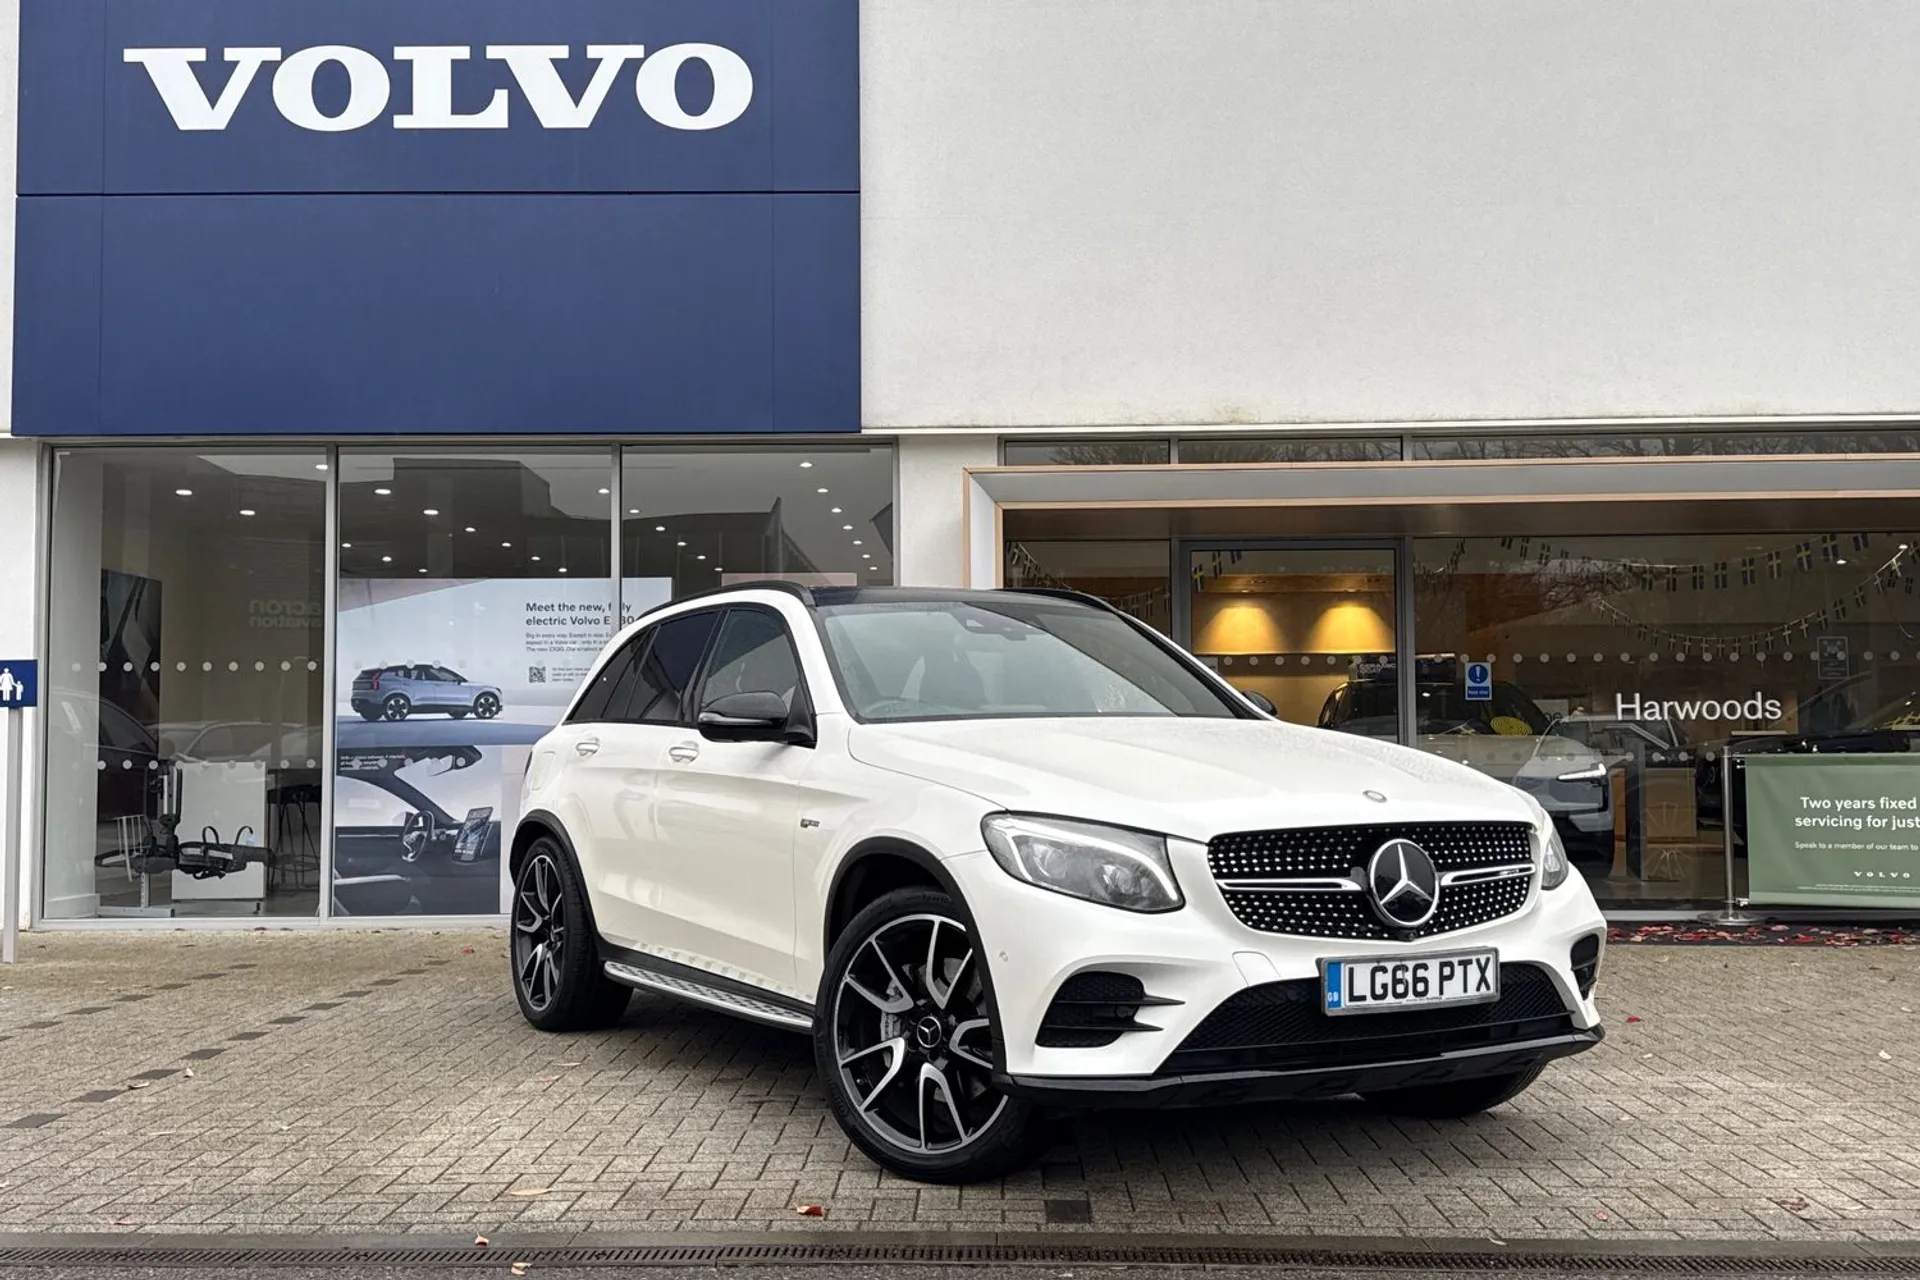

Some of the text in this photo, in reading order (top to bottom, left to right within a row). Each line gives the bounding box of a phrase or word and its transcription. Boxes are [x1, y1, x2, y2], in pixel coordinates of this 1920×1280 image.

[123, 42, 753, 131] VOLVO
[526, 603, 555, 612] Meet
[558, 602, 576, 612] the
[579, 604, 605, 613] new,
[526, 616, 567, 626] electric
[570, 616, 600, 625] Volvo
[1616, 691, 1782, 720] Harwoods
[1800, 796, 1917, 812] Two years fixed
[1794, 815, 1920, 830] servicing for just
[1794, 841, 1817, 850] Speak
[1834, 842, 1864, 850] member
[1889, 843, 1909, 851] team
[1910, 843, 1919, 851] to
[1348, 956, 1491, 1002] LG66 PTX
